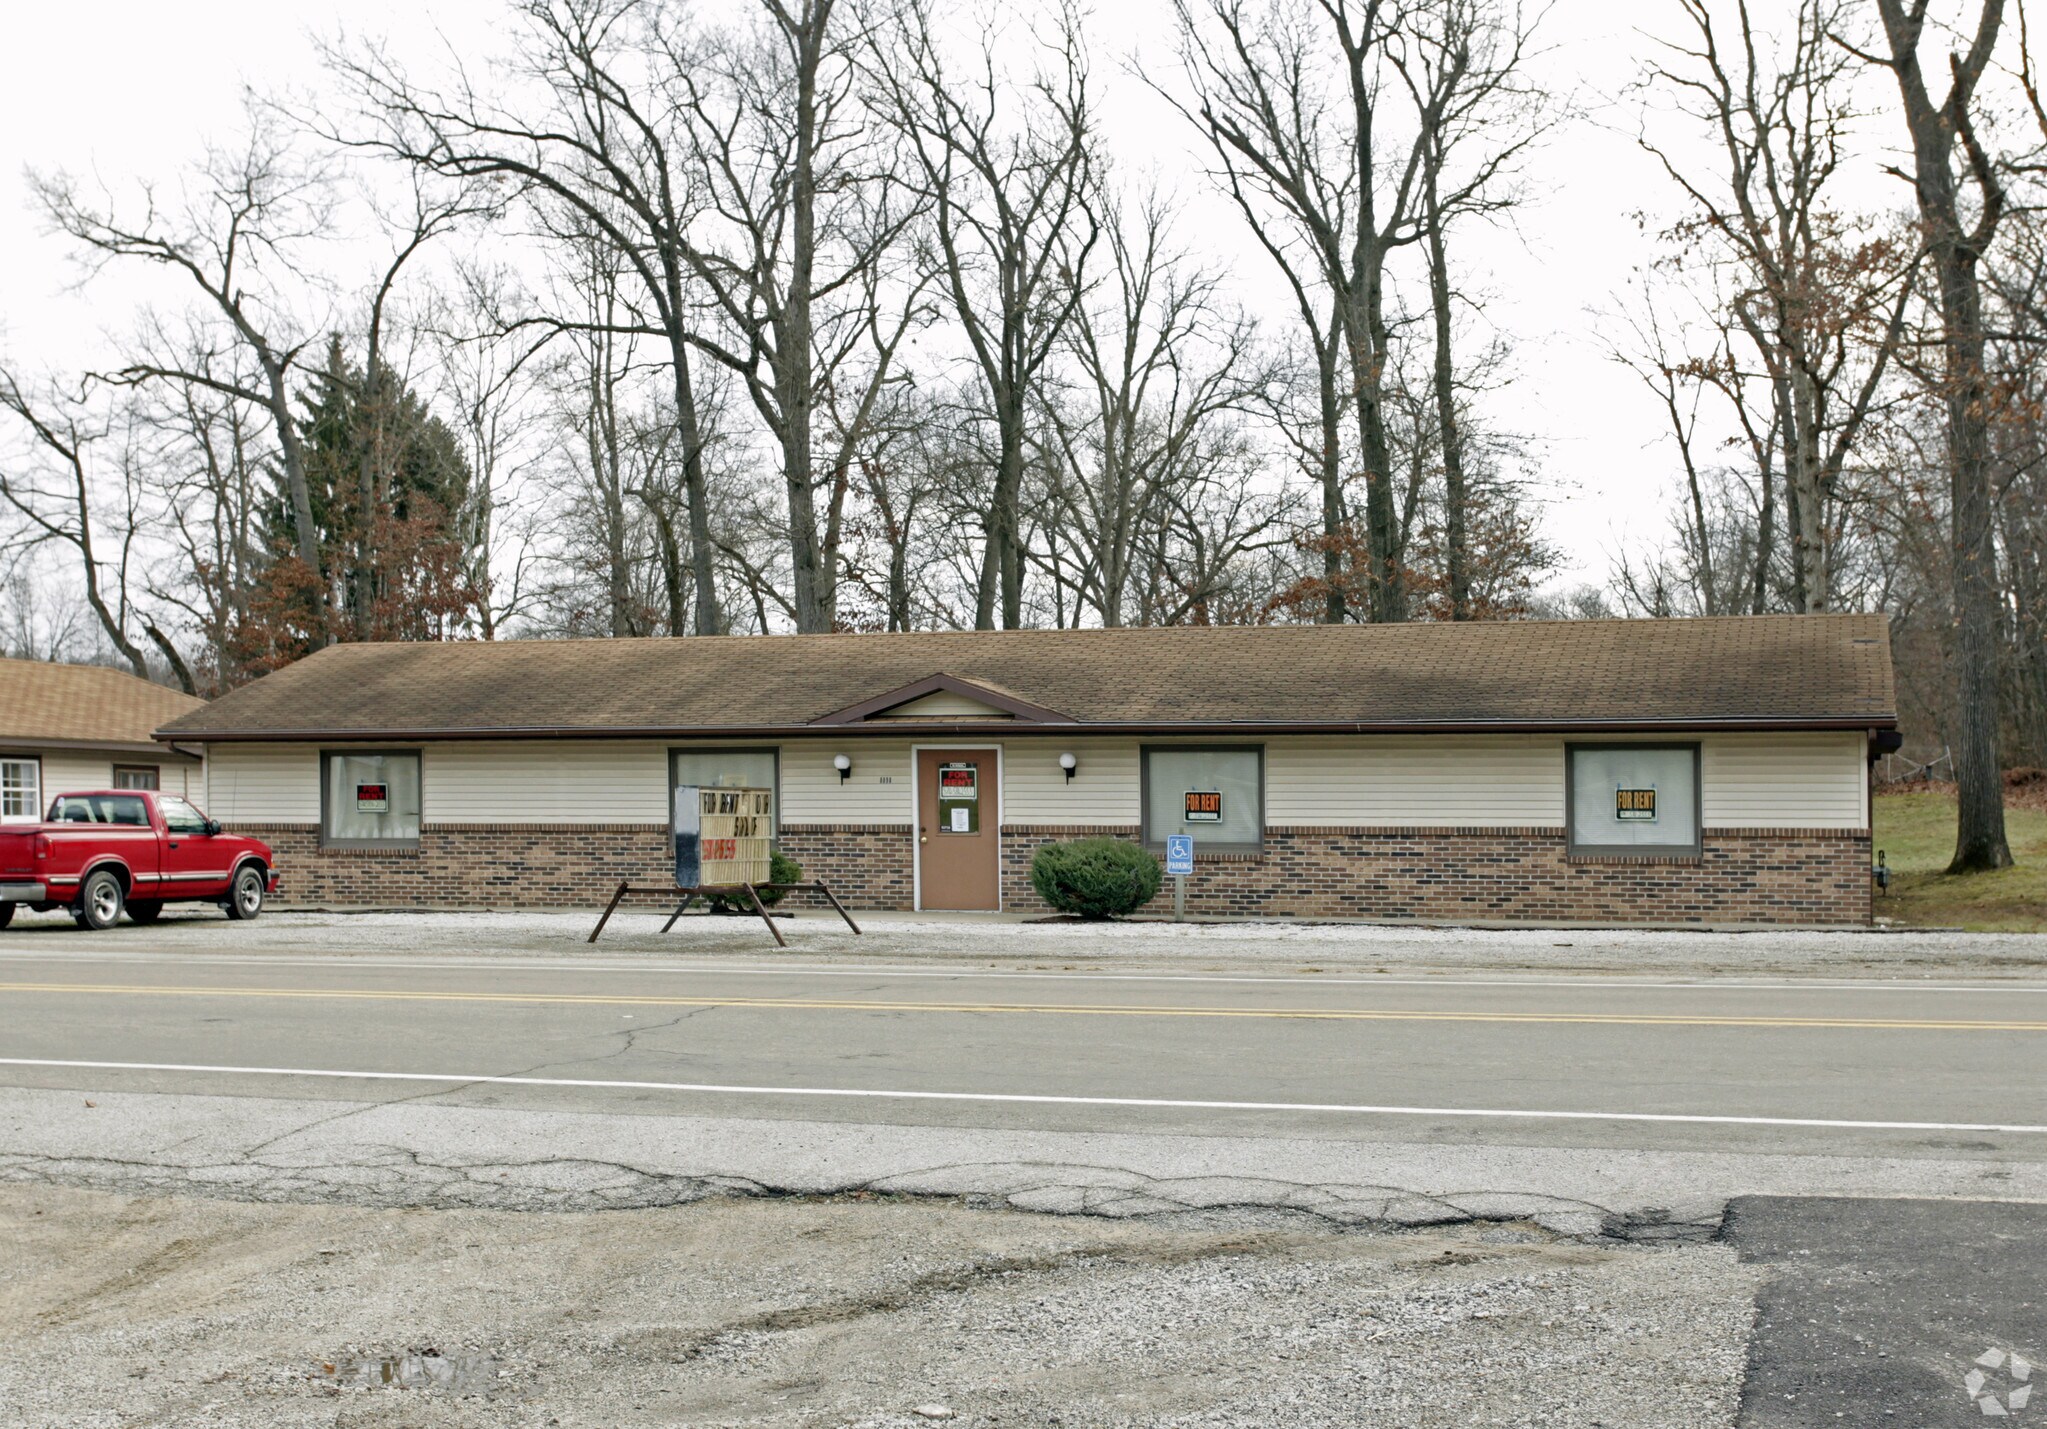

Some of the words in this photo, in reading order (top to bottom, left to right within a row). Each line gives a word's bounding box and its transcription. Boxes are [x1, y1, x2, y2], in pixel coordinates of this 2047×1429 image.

[704, 793, 716, 814] FOR
[1187, 795, 1199, 811] FOR
[1201, 795, 1219, 811] RENT
[1618, 792, 1632, 809] FOR
[1634, 792, 1654, 809] RENT
